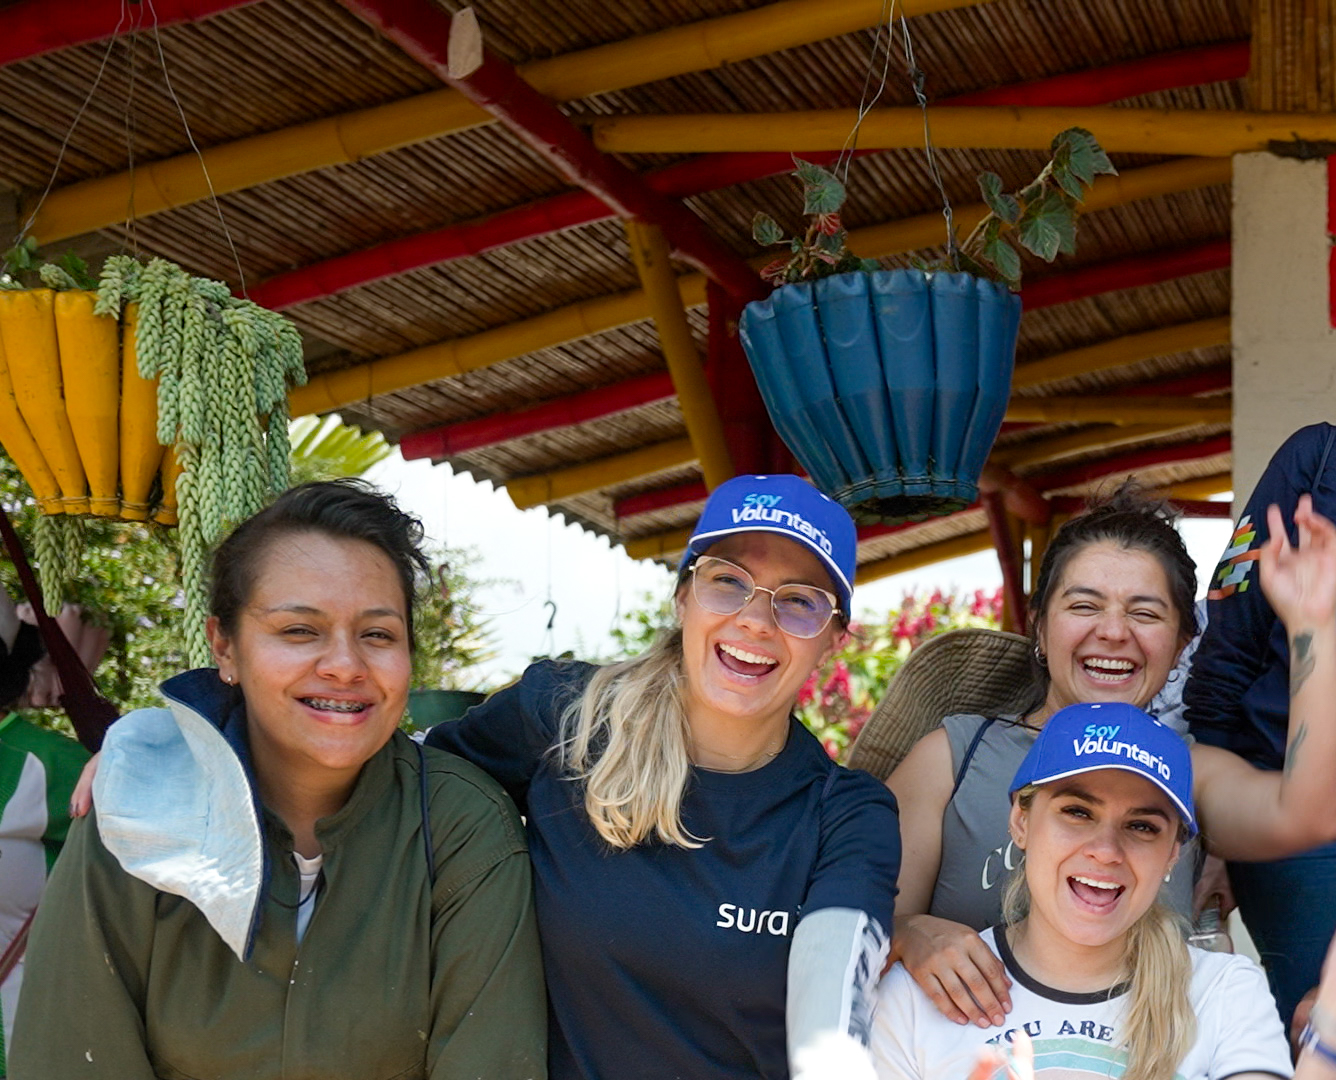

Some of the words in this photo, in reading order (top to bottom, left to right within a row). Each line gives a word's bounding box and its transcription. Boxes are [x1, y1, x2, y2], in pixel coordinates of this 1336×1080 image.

[731, 504, 833, 556] Voluntario
[1073, 736, 1171, 781] Voluntario
[716, 903, 789, 936] sura
[1057, 1020, 1114, 1042] ARE
